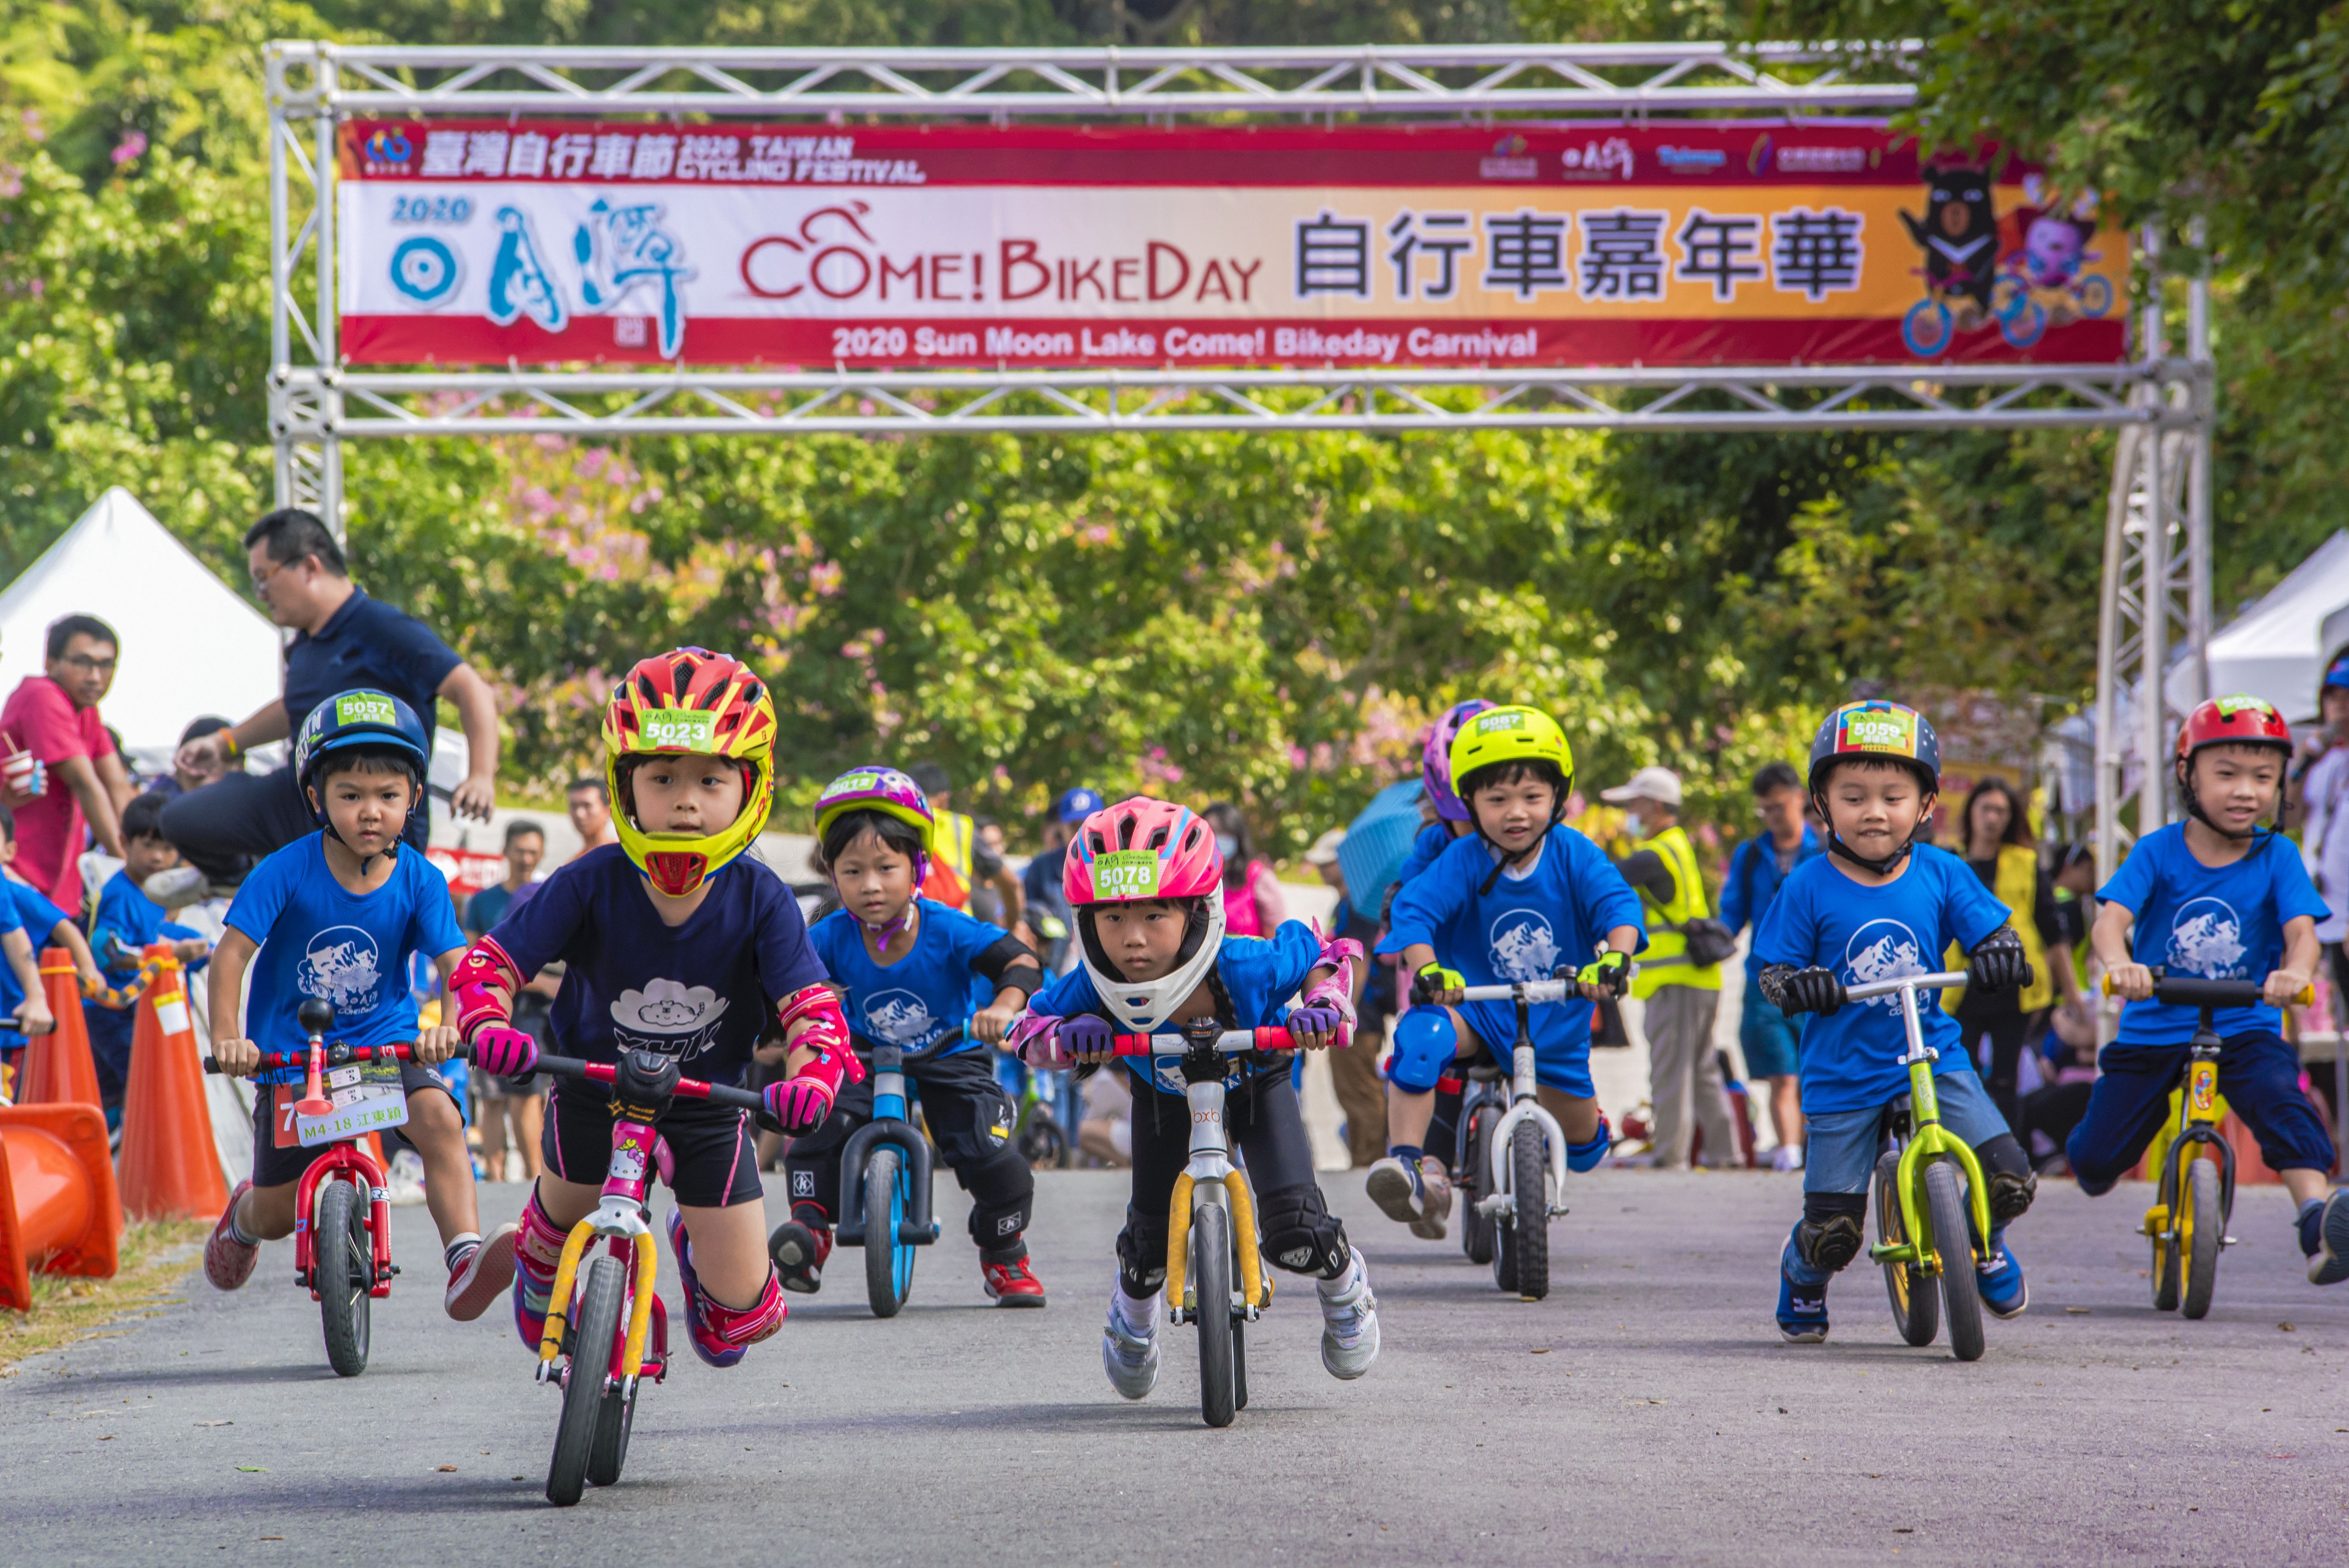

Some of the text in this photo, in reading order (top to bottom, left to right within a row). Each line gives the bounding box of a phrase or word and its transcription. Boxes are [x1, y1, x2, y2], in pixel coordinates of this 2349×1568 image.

[420, 131, 678, 179] 臺灣自行車節
[680, 135, 854, 159] 2020 TAIWAN
[675, 158, 926, 184] CYCLING FESTIVAL
[391, 197, 472, 222] 2020
[1293, 209, 1862, 301] 自行車嘉年華
[832, 328, 1538, 361] 2020 Sun Moon Lake Come! Bikeday Carnival
[343, 701, 388, 716] 5057
[646, 722, 706, 741] 5023
[1854, 722, 1900, 738] 5059
[1100, 866, 1151, 888] 5078
[1193, 1107, 1220, 1123] bxb
[304, 1117, 352, 1139] M4-18
